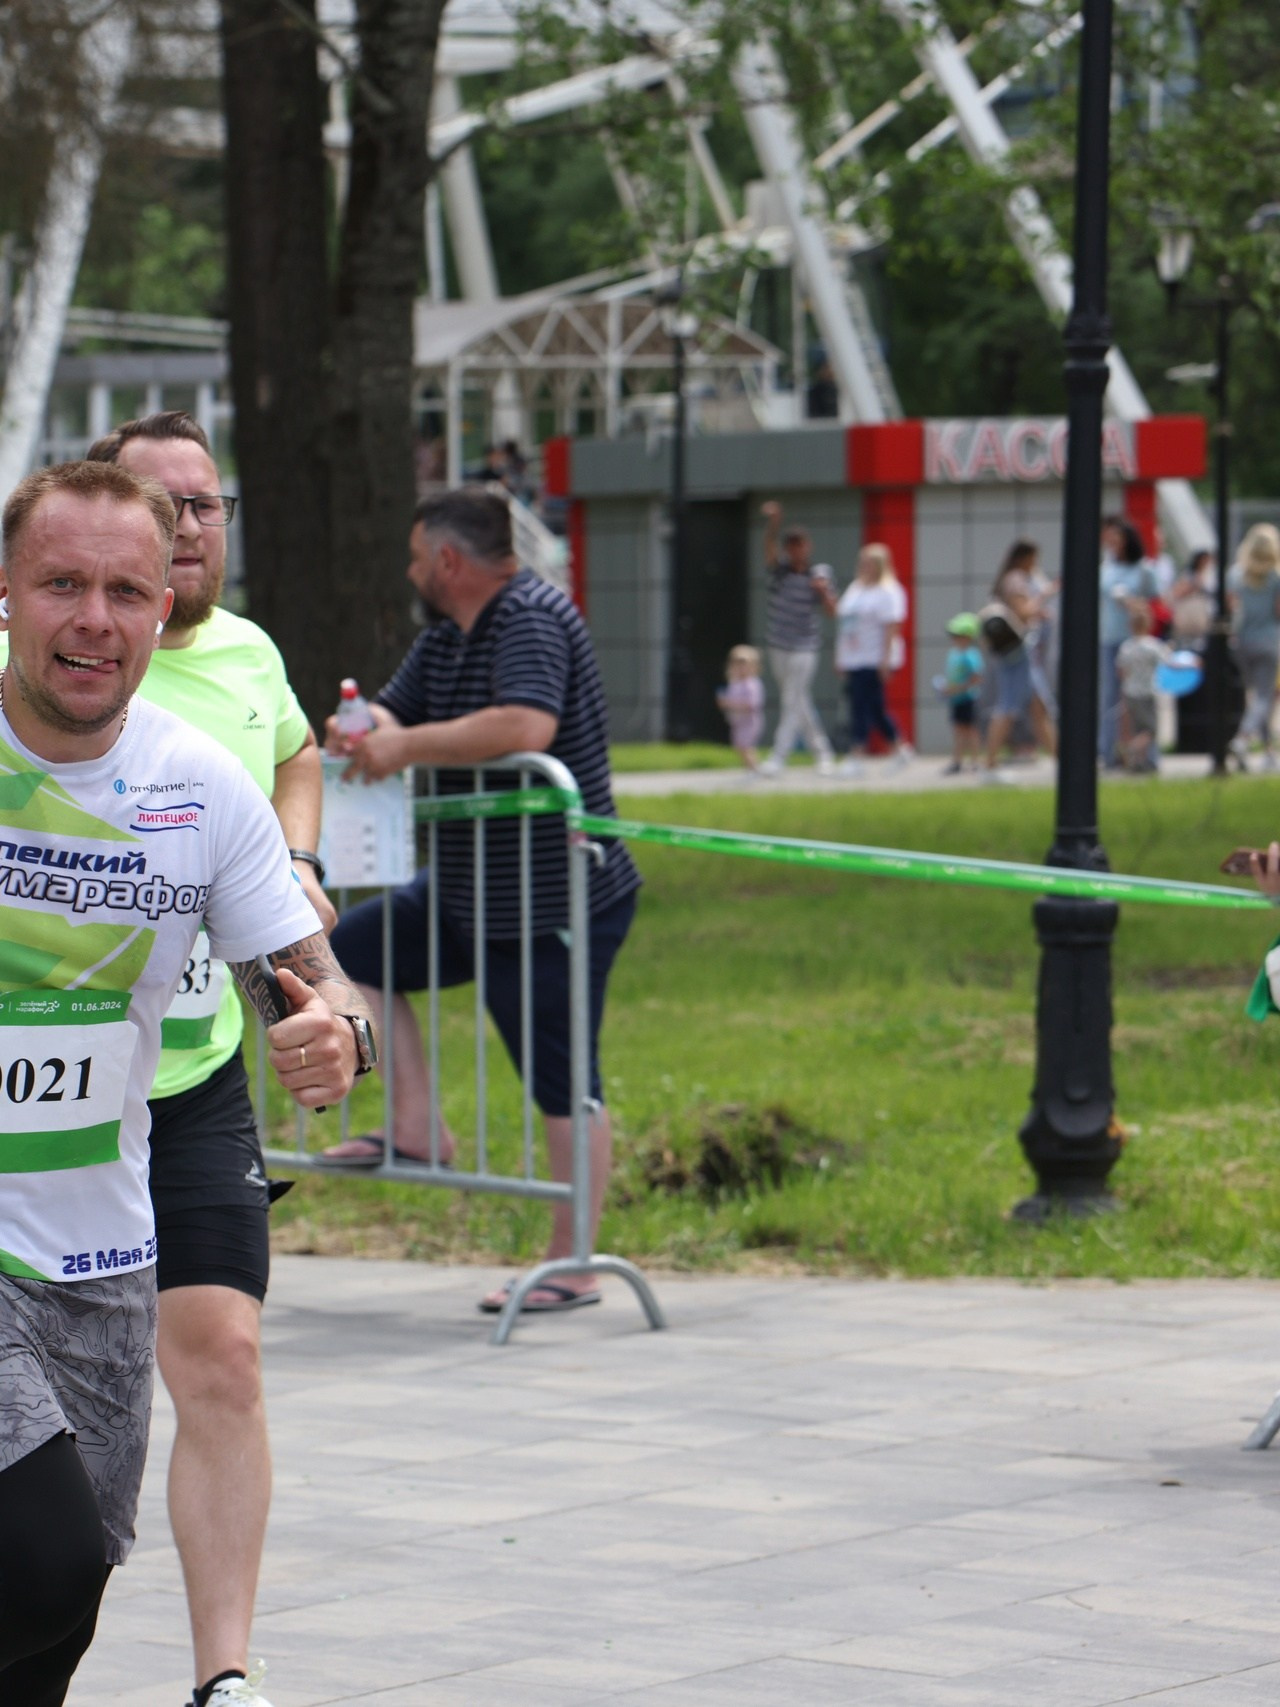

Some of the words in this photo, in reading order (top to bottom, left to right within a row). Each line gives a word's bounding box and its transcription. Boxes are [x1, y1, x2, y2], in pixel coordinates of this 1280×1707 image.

[137, 812, 198, 825] ЛИПЕЦКОЕ
[71, 1001, 122, 1012] 01.06.2024
[62, 1252, 91, 1275] 26
[96, 1247, 142, 1270] Мая
